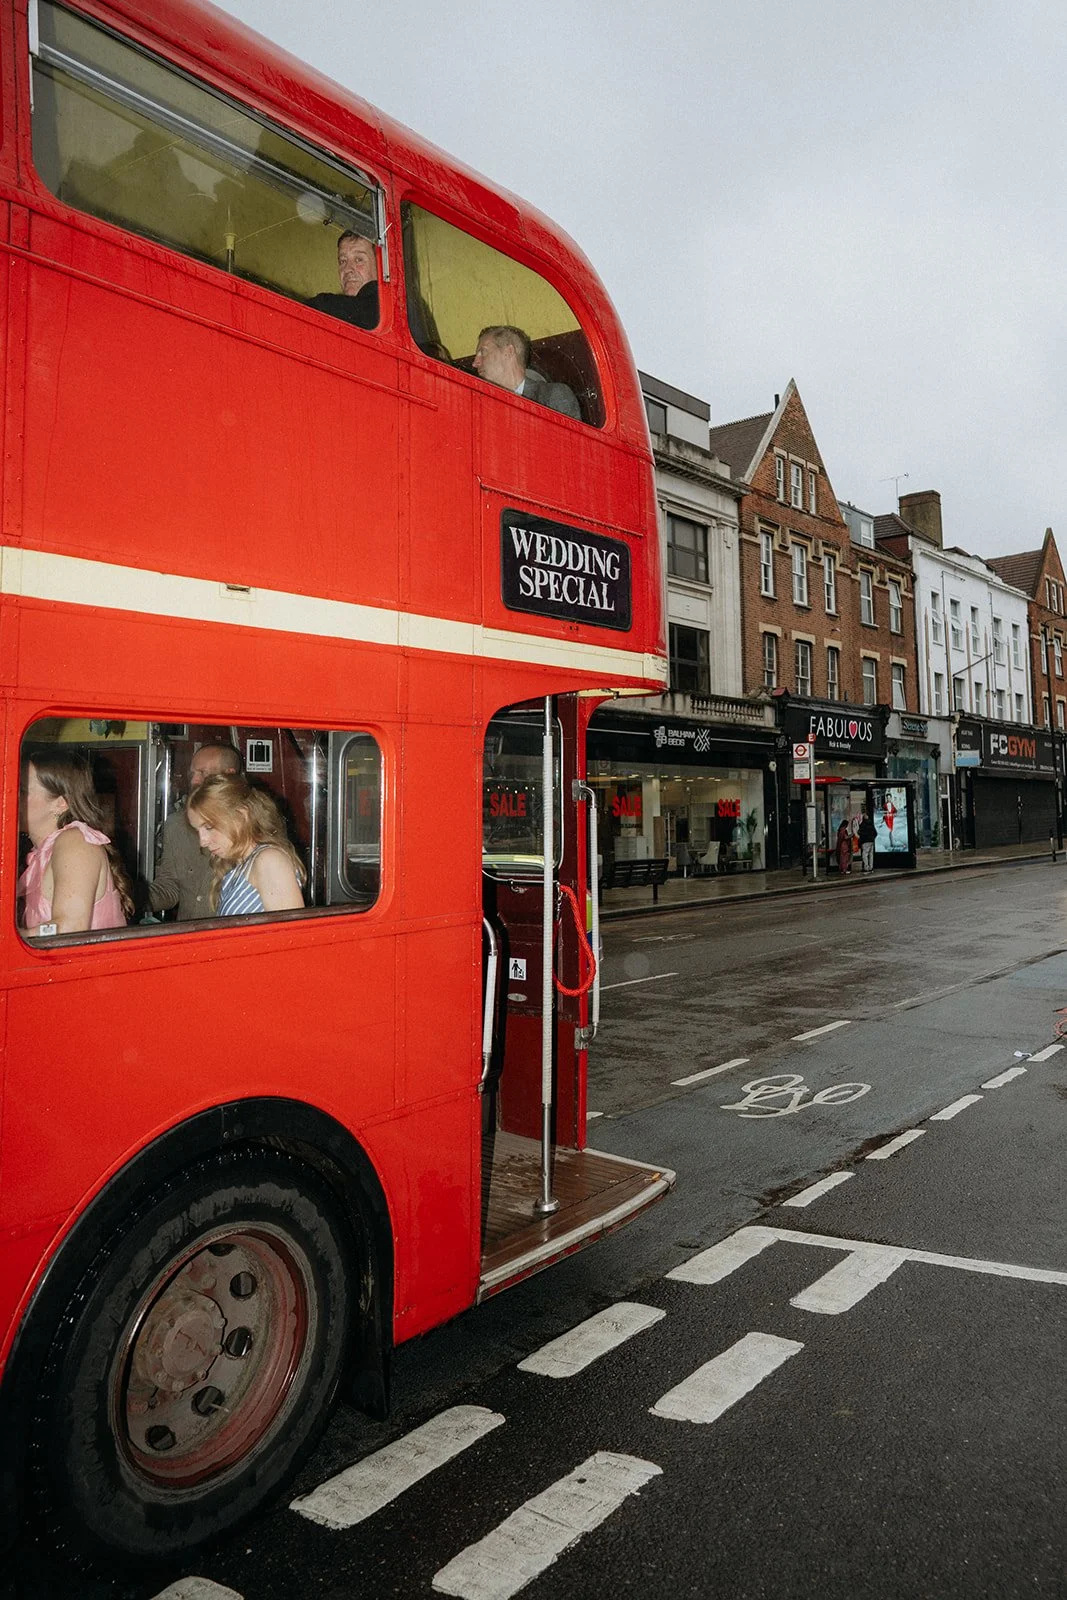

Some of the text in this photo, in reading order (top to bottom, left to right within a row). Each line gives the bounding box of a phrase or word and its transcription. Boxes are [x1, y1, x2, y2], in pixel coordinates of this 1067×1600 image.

[509, 526, 620, 581] WEDDING
[519, 565, 615, 612] SPECIAL
[667, 729, 696, 739] BALHAM
[808, 733, 815, 742] E
[810, 715, 873, 742] FABULOUS
[667, 738, 686, 747] BEDS
[490, 793, 527, 817] SALE
[612, 795, 642, 817] SALE
[717, 799, 741, 817] SALE
